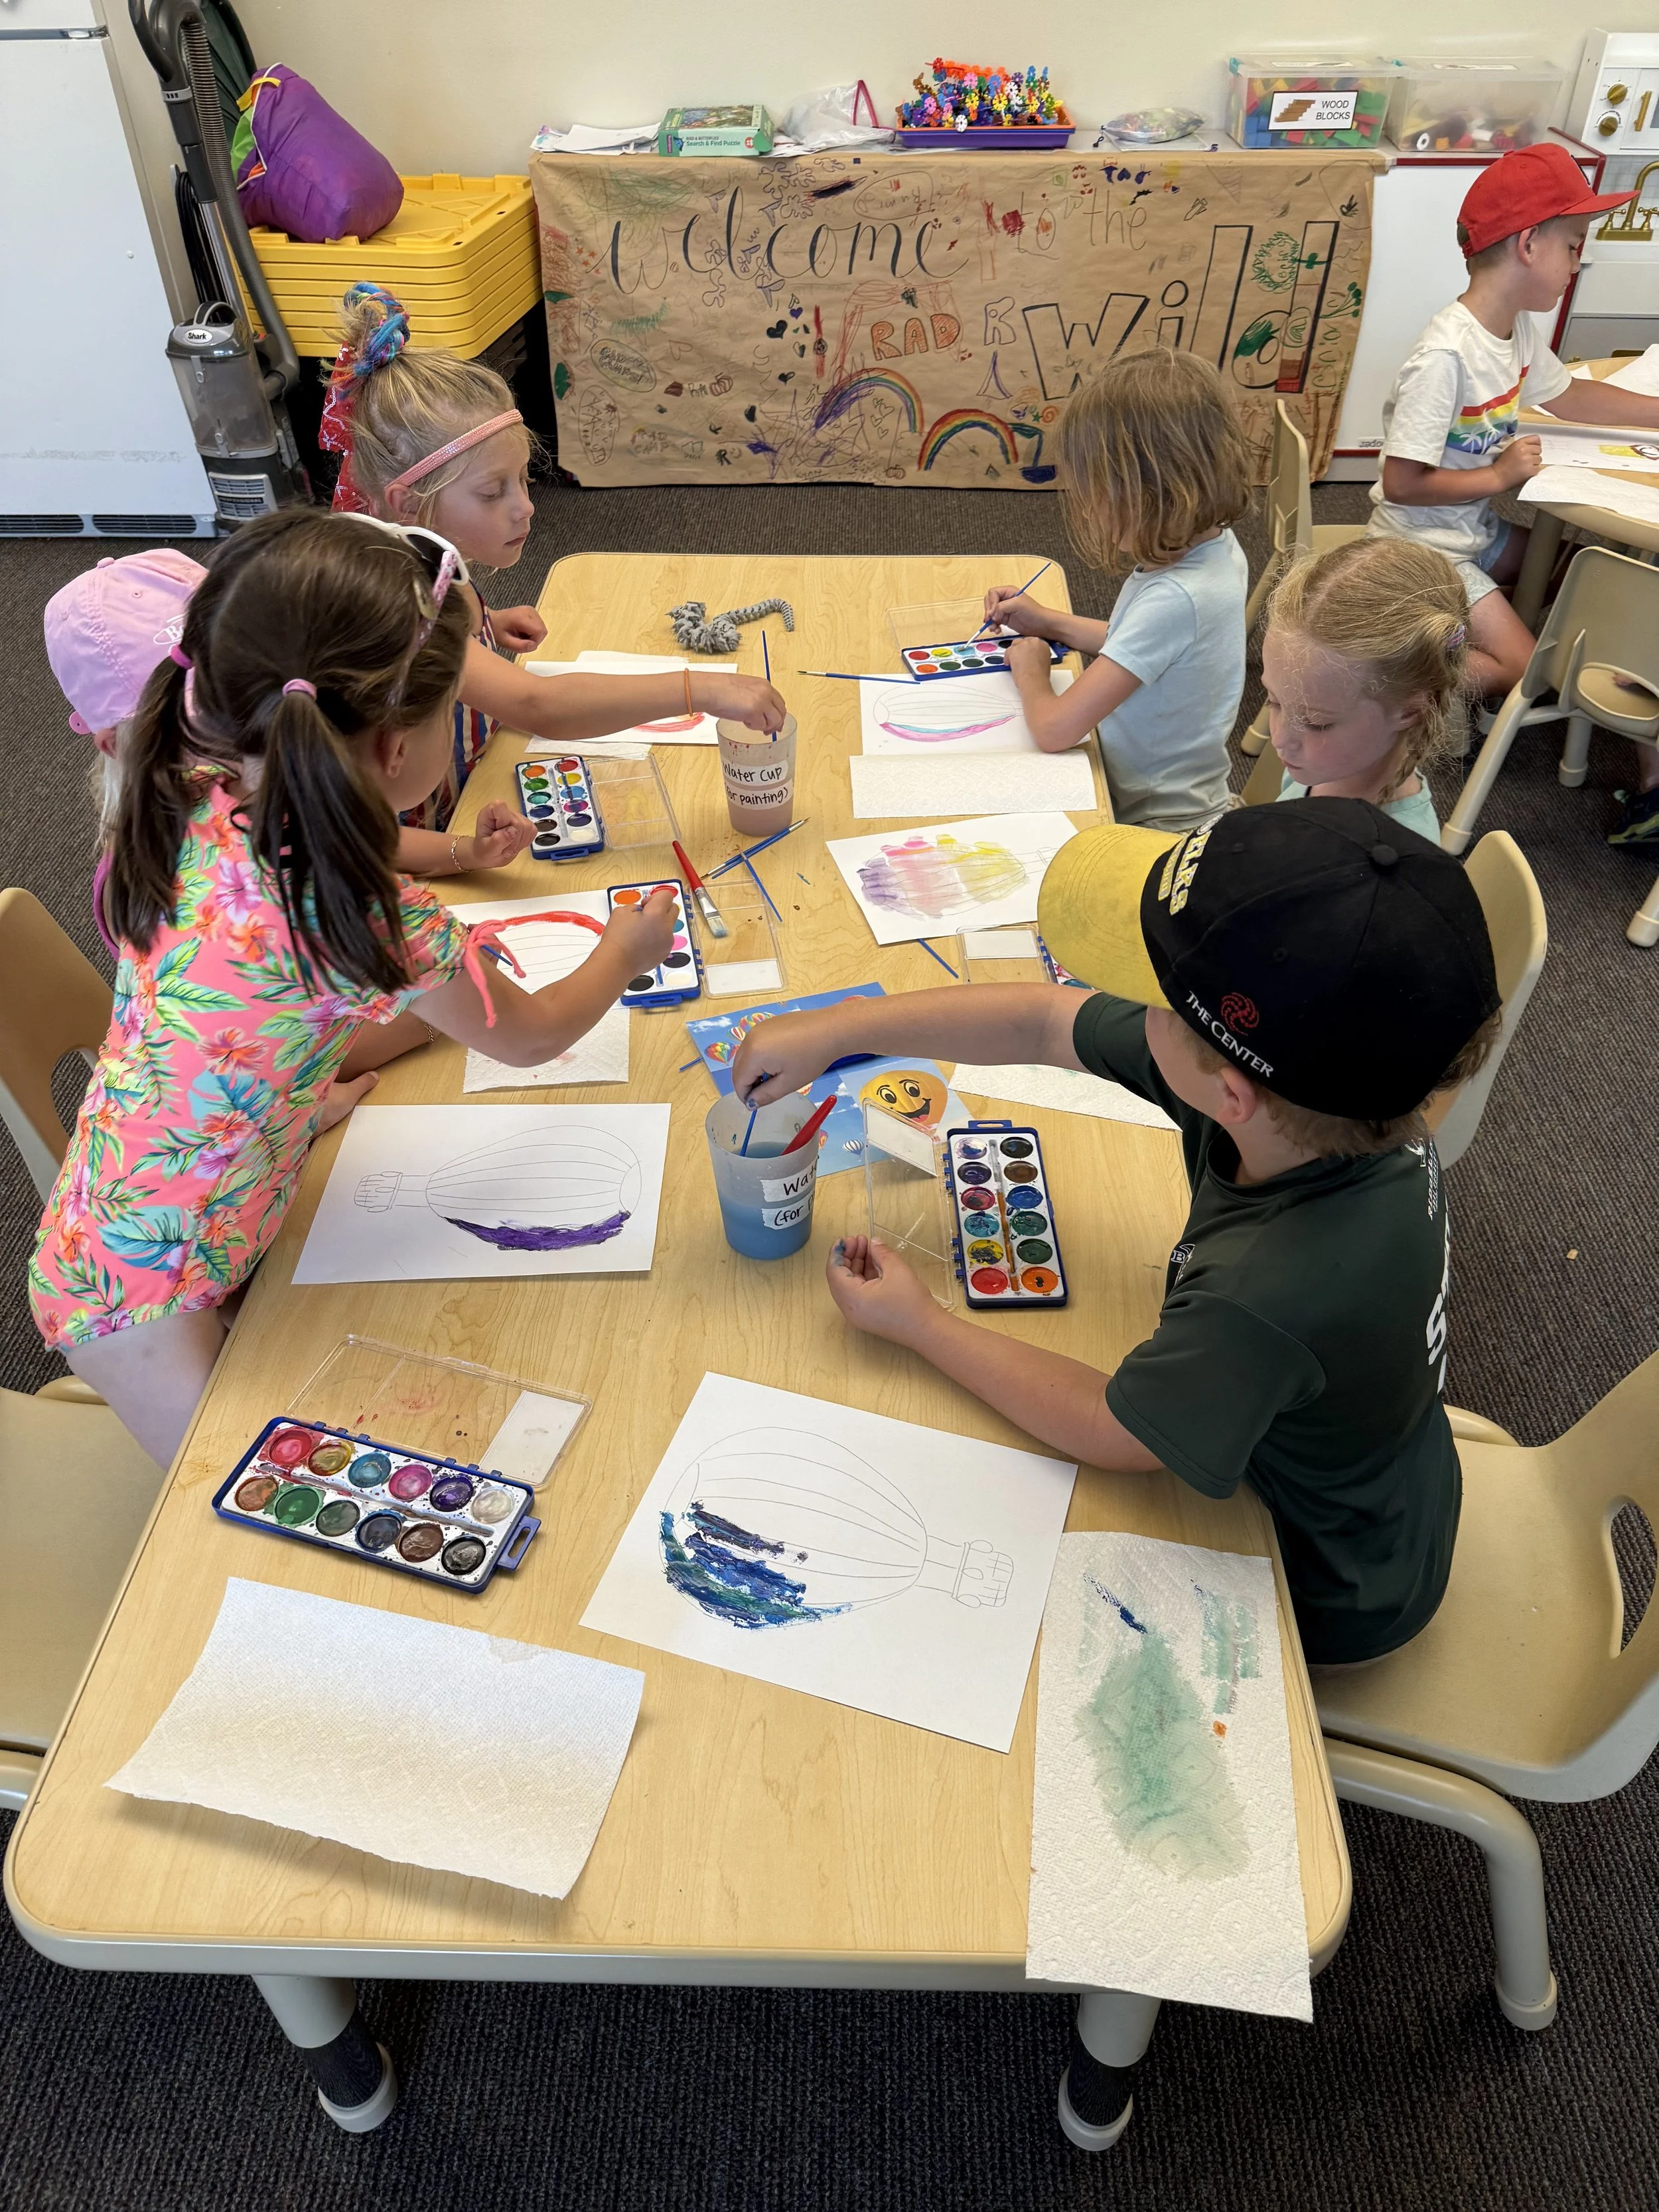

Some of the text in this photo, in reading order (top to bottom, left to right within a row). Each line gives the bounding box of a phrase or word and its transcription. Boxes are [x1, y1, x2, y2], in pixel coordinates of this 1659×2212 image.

[1316, 111, 1350, 120] BLOCKS
[1322, 100, 1349, 109] WOOD
[1016, 187, 1147, 259] to the
[1022, 220, 1339, 402] Wild
[188, 332, 207, 340] Shark
[871, 313, 961, 360] RAD
[723, 762, 782, 782] Water Cup
[740, 787, 788, 805] painting)
[1169, 830, 1213, 915] ELKS
[1186, 990, 1274, 1077] THE CENTER
[783, 1158, 818, 1196] Wat
[774, 1205, 804, 1226] (for
